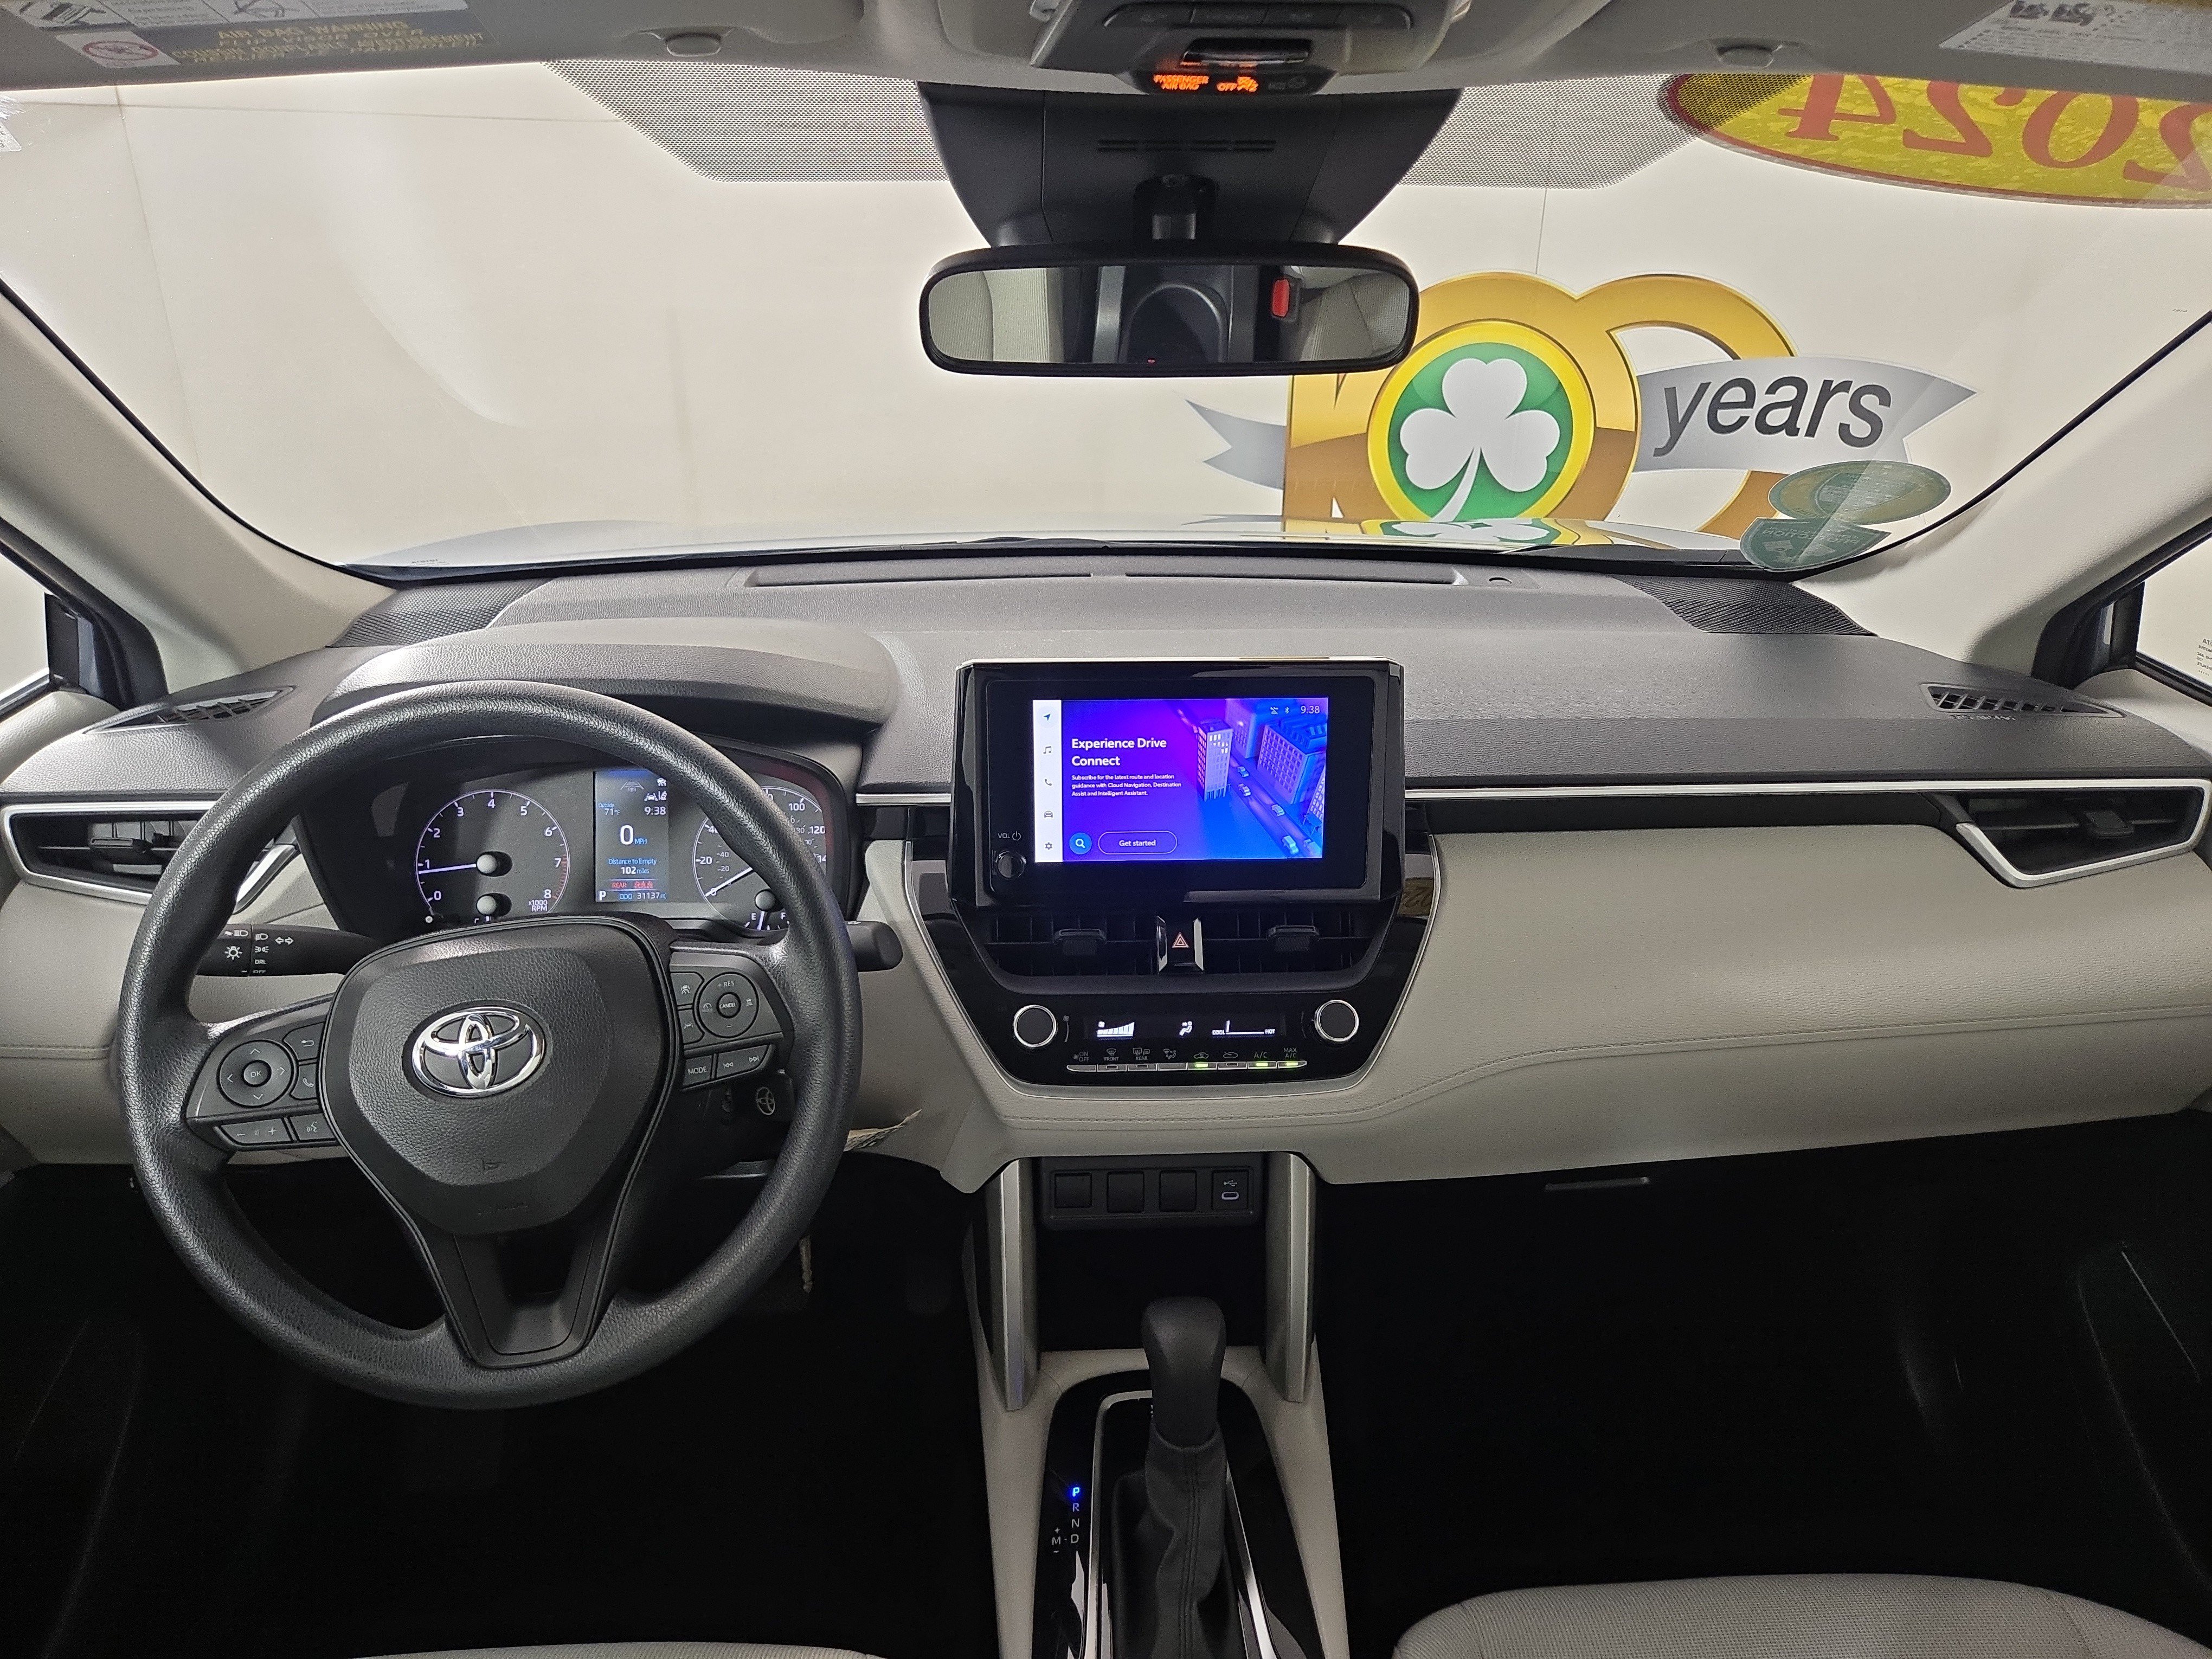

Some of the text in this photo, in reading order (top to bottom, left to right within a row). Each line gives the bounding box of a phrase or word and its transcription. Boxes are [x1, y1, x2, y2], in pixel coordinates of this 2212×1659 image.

[218, 21, 409, 39] AIR BAG WARNING
[1154, 75, 1209, 83] PASSENGER
[1217, 82, 1237, 91] OFF
[1653, 376, 1891, 457] years
[1301, 705, 1320, 714] 9:38
[1072, 737, 1167, 751] Experience Drive
[1072, 756, 1121, 766] Connect
[488, 799, 496, 808] 4
[789, 803, 805, 811] 100
[458, 807, 464, 816] 3
[520, 806, 527, 815] 5
[645, 806, 666, 815] 9:38
[434, 828, 441, 838] 2
[545, 827, 552, 836] 6
[809, 826, 825, 834] 120
[620, 825, 634, 845] 0
[425, 859, 430, 869] 1
[554, 858, 562, 867] 7
[700, 857, 712, 865] 20
[621, 866, 636, 874] 102
[434, 891, 441, 900] 0
[544, 889, 551, 898] 8
[599, 890, 606, 901] P
[687, 1066, 707, 1075] MODE
[1072, 1487, 1080, 1497] P
[1072, 1502, 1080, 1512] R
[1071, 1518, 1080, 1528] N
[1052, 1536, 1061, 1545] M
[1071, 1534, 1079, 1544] D
